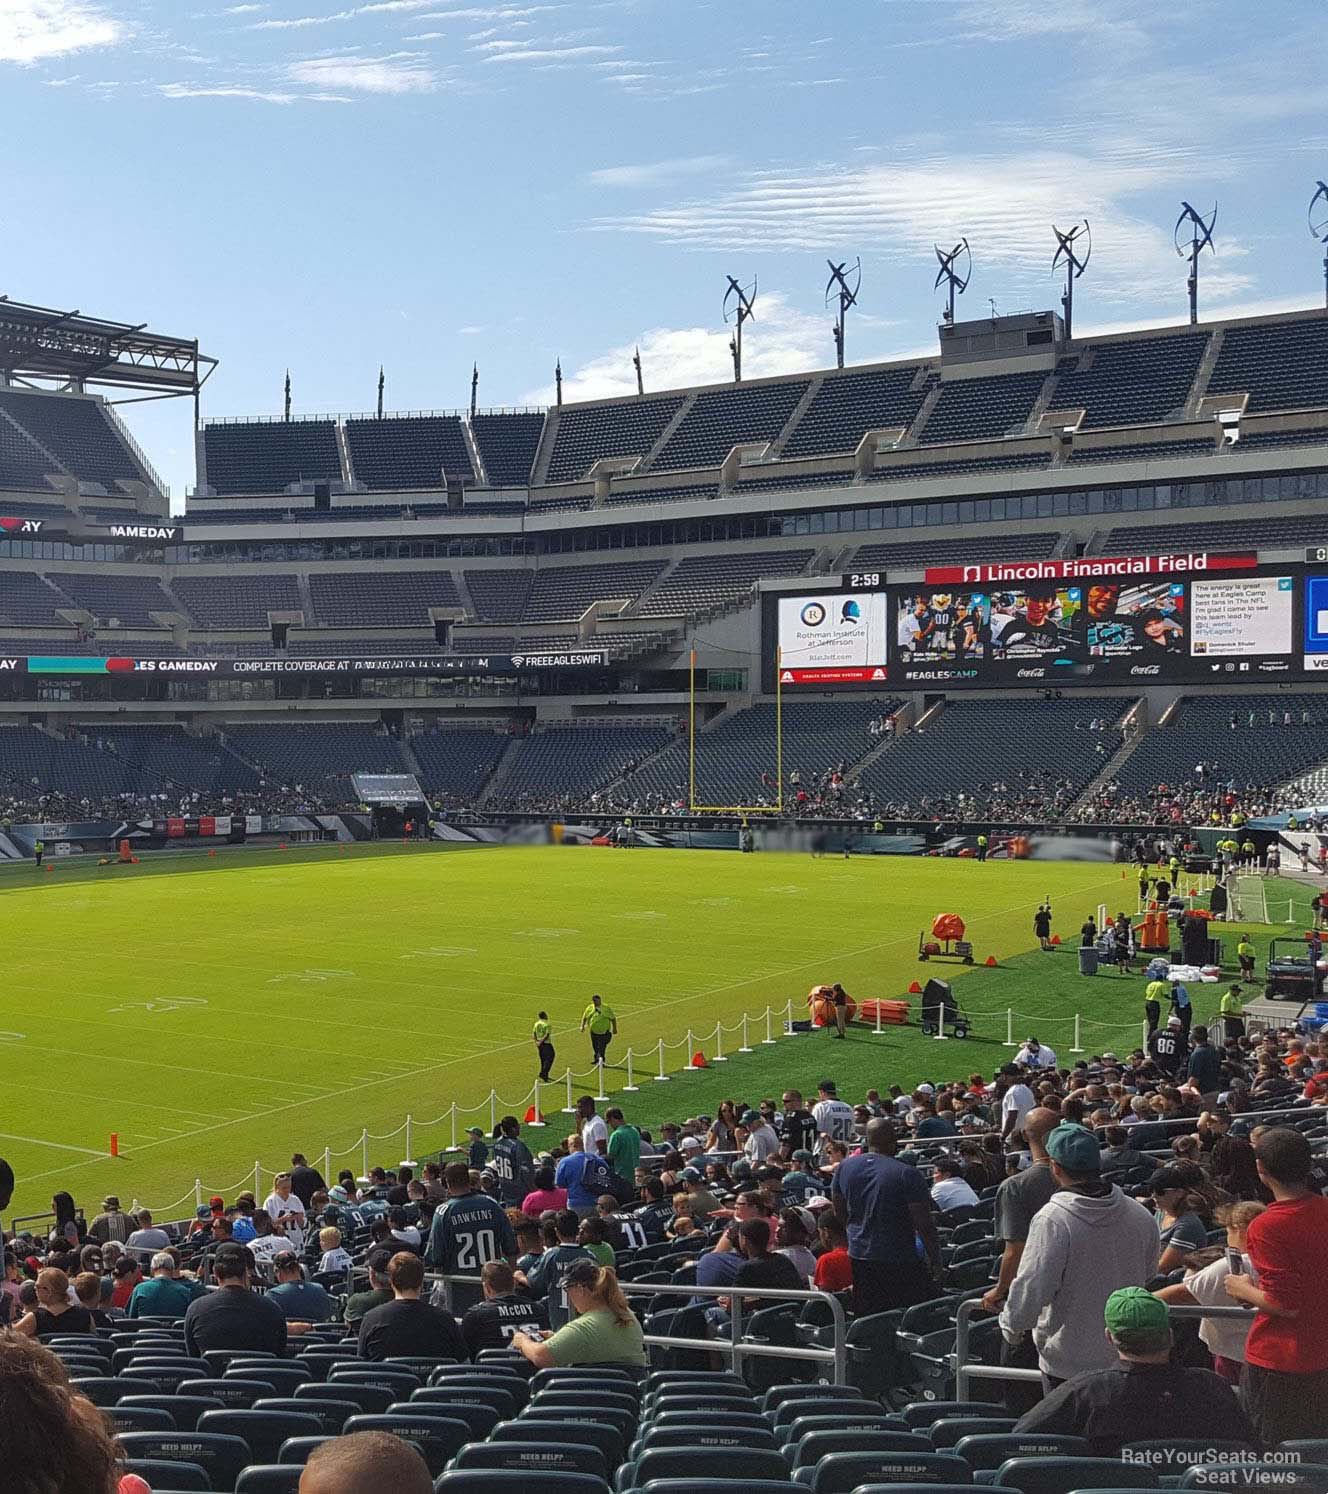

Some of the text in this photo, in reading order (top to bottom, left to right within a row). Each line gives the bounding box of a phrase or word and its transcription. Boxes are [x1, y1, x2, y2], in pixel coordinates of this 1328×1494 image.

[988, 553, 1207, 581] Lincoln Financial Field
[851, 573, 880, 587] 2:59
[809, 610, 818, 619] R
[796, 631, 831, 639] Rothman
[158, 661, 218, 671] GAMEDAY
[233, 661, 283, 672] COMPLETE
[285, 660, 336, 671] COVERAGE
[337, 660, 349, 670] AT
[906, 670, 978, 680] #EAGLESCAMP
[1158, 1038, 1176, 1055] 86
[495, 1155, 514, 1180] 36
[451, 1209, 493, 1226] DAWKINS
[622, 1222, 648, 1250] 11
[455, 1229, 497, 1269] 20
[498, 1304, 534, 1317] McCOY
